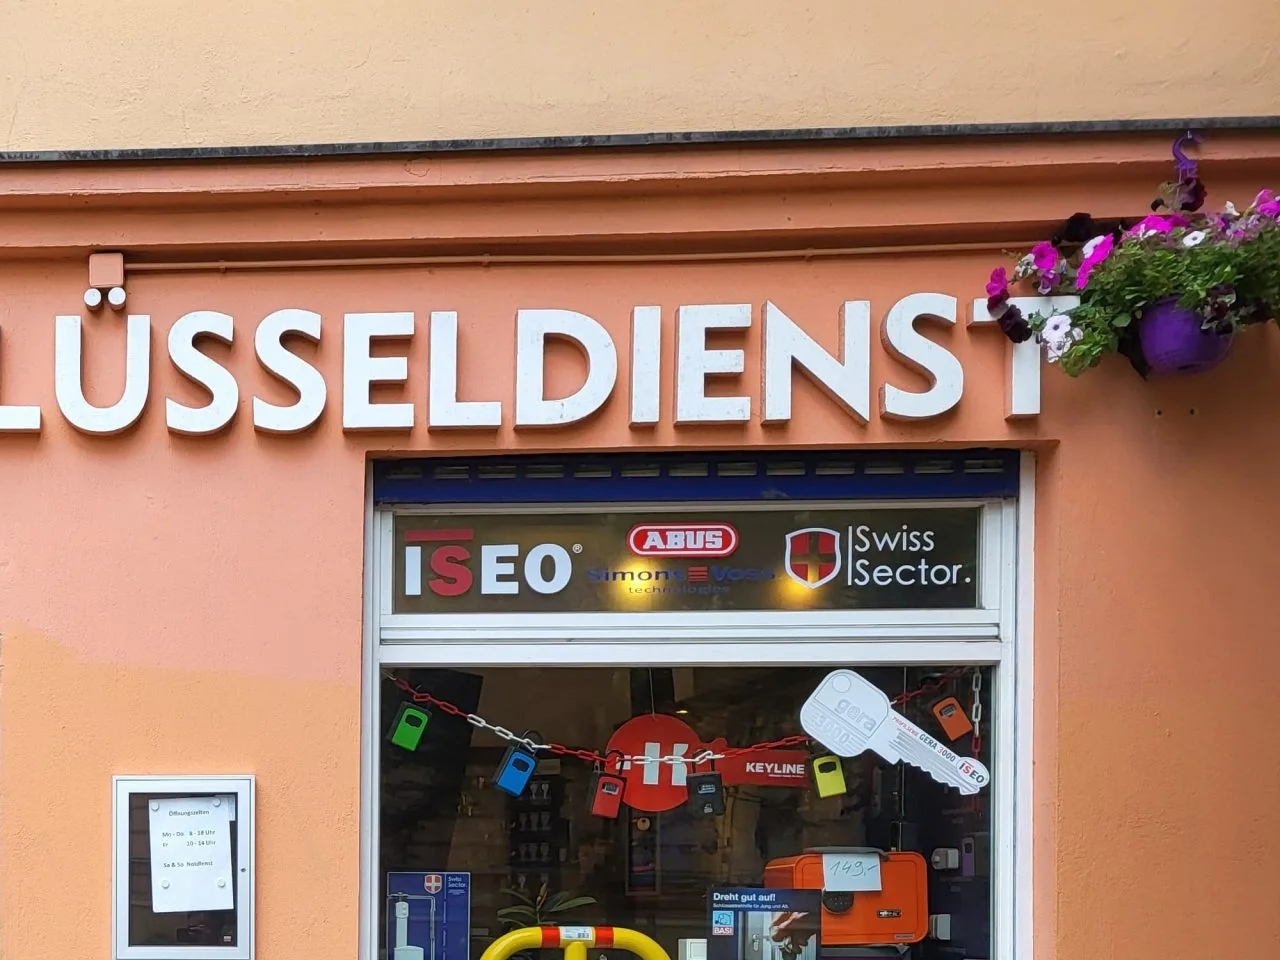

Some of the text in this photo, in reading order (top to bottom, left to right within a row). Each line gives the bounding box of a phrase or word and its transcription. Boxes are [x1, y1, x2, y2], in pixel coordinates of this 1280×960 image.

[642, 530, 723, 549] ABUS
[854, 525, 935, 552] Swiss
[854, 559, 971, 586] Sector.
[919, 733, 938, 750] GERA
[937, 746, 956, 762] 3000
[746, 762, 805, 775] KEYLINE
[959, 761, 985, 784] ISEO
[713, 892, 776, 902] Dreht gut auf!
